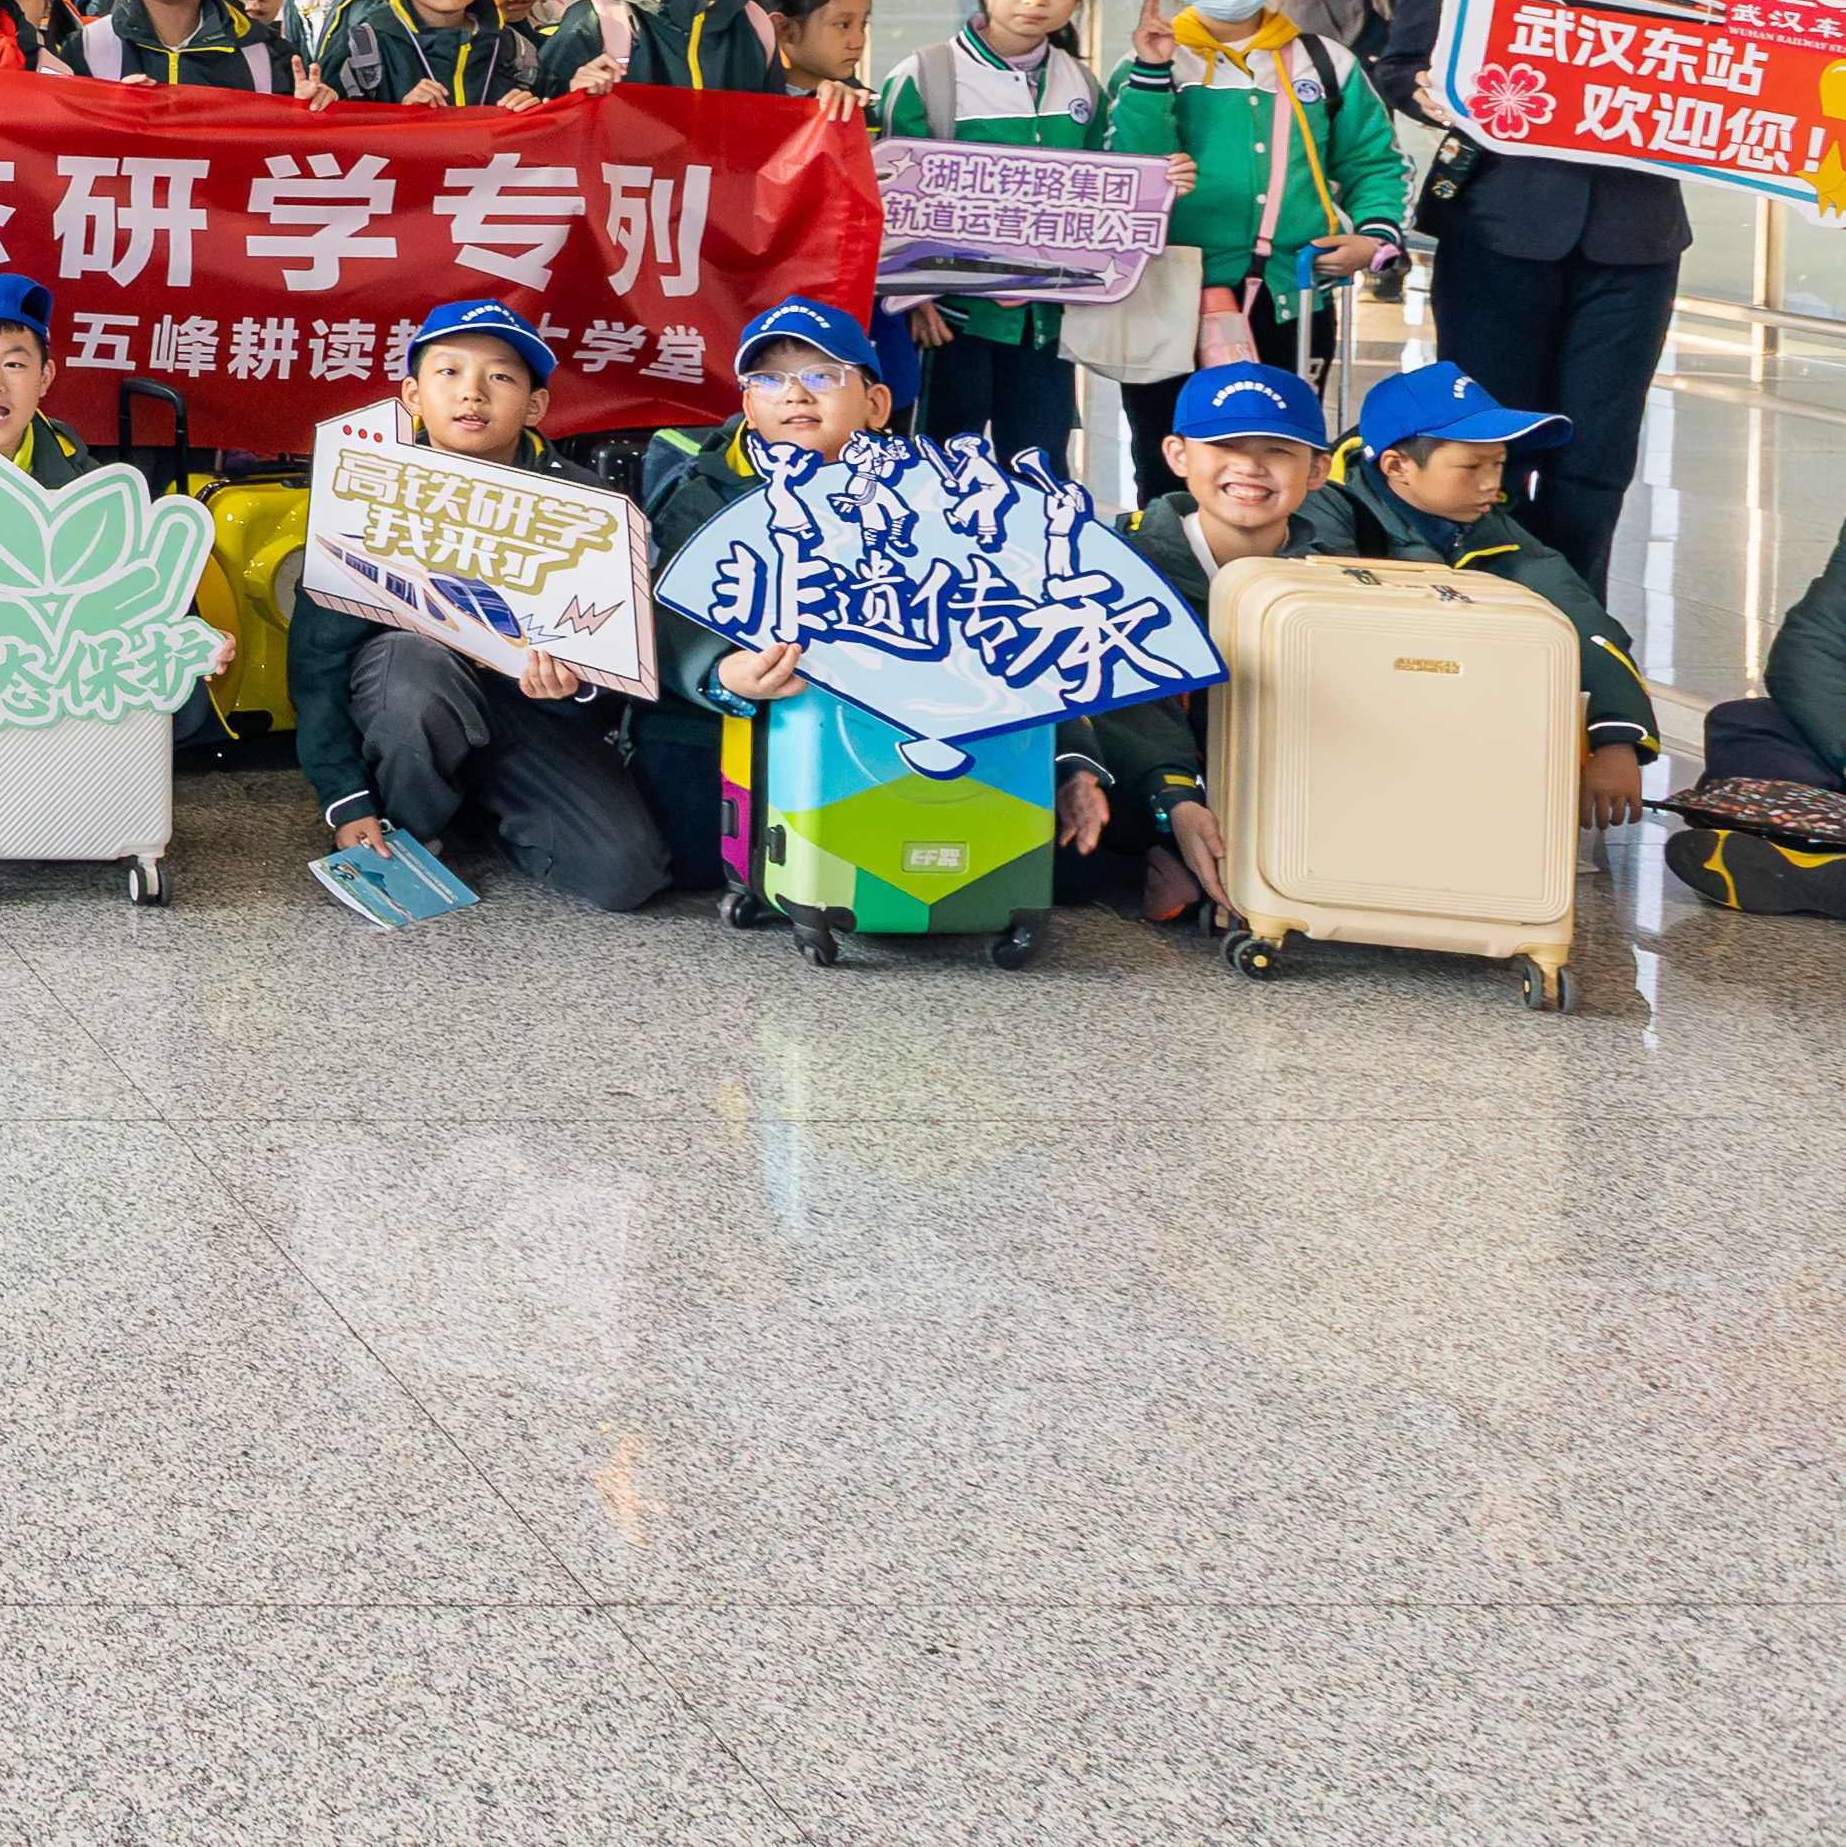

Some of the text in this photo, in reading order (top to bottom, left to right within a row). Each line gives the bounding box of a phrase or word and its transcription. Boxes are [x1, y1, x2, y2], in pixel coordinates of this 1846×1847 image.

[1509, 5, 1769, 97] 武汉东站
[1728, 26, 1774, 41] WUHAN
[1731, 4, 1846, 38] 武汉车
[1576, 85, 1825, 174] 欢迎您!
[925, 157, 1137, 206] 湖北铁路集团
[886, 195, 1166, 249] 轨道运营有限公司
[65, 311, 709, 385] 五峰耕读学堂
[334, 454, 611, 546] 高铁研学
[367, 506, 567, 587] 我来了
[714, 534, 1185, 703] 非遗传承
